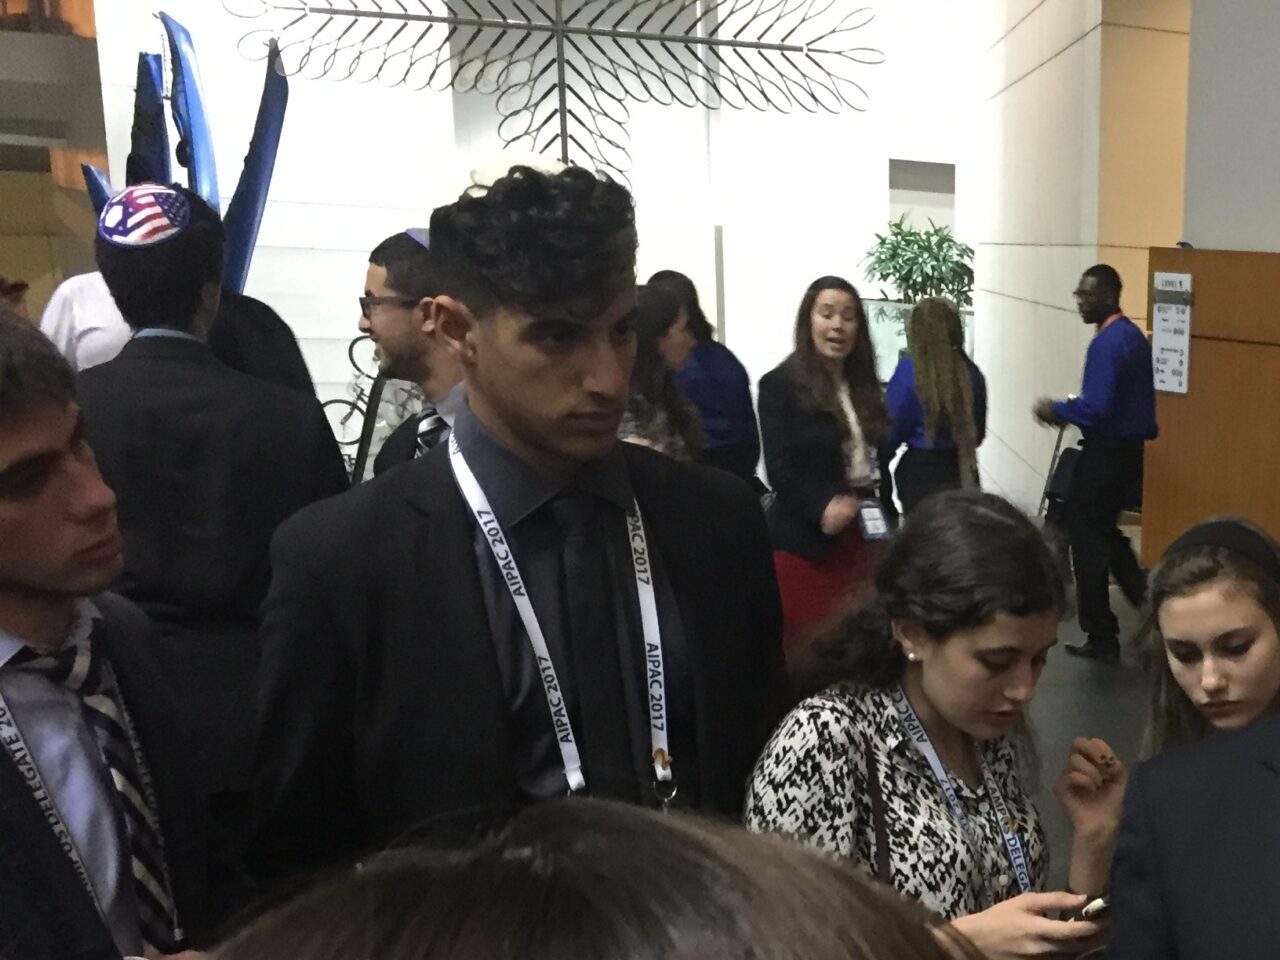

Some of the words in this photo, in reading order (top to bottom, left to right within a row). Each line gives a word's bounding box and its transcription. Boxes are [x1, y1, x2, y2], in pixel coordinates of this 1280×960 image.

[476, 510, 505, 547] 2017
[628, 511, 644, 543] PAC
[496, 549, 525, 597] AIPAC
[634, 547, 650, 585] 2017
[537, 656, 558, 694] 2017
[647, 642, 662, 689] AIPAC
[550, 696, 573, 743] AIPAC
[651, 693, 665, 731] 2017
[897, 704, 927, 743] AIPAC
[1007, 835, 1030, 893] DELEGA
